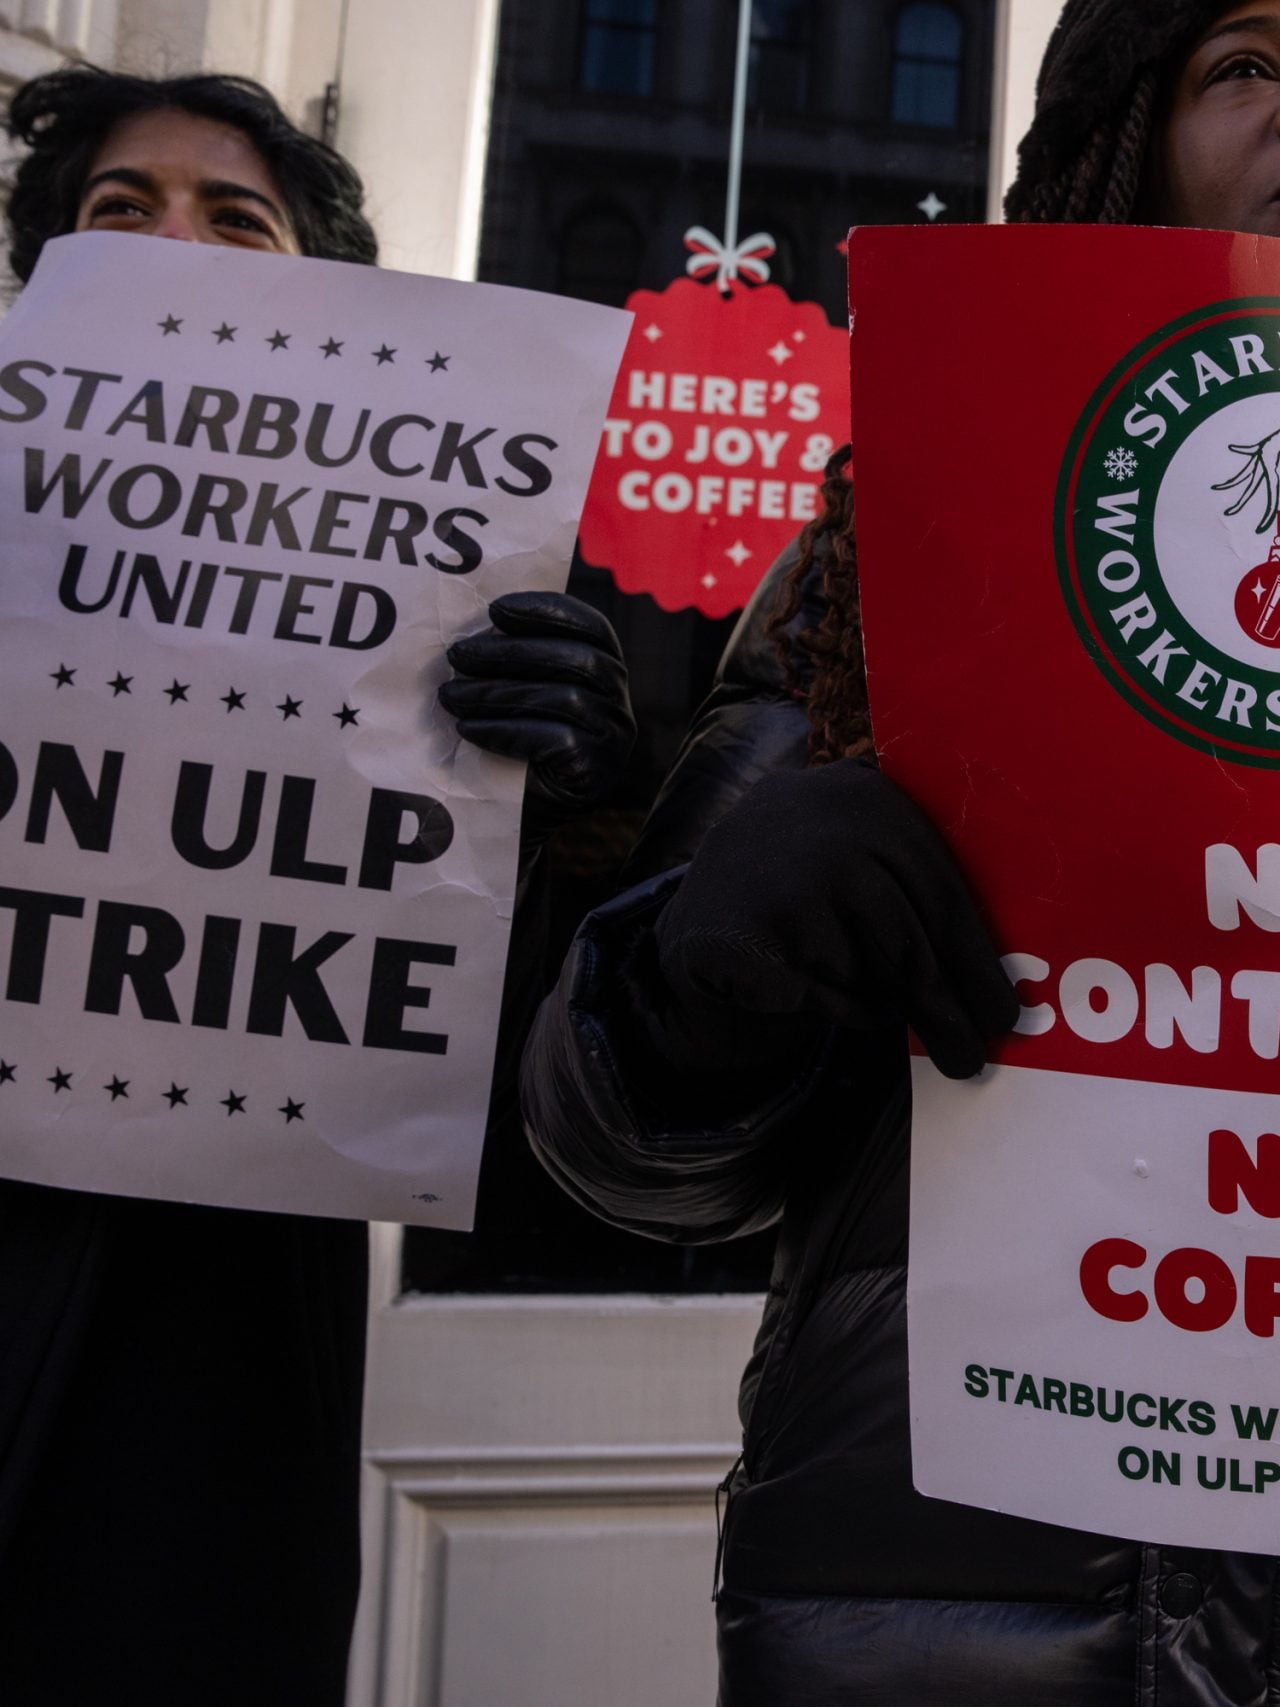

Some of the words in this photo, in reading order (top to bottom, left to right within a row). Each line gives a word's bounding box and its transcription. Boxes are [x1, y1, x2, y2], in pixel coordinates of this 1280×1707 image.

[0, 359, 559, 498] STARBUCKS
[628, 370, 822, 422] HERE'S
[604, 417, 673, 461] TO
[685, 425, 789, 469] JOY
[800, 433, 834, 472] &
[23, 447, 490, 576] WORKERS
[617, 470, 818, 521] COFFEE
[56, 545, 398, 652] UNITED
[0, 740, 125, 854] N
[170, 760, 455, 892] ULP
[963, 1364, 1216, 1436] STARBUCKS
[1118, 1446, 1181, 1485] ON
